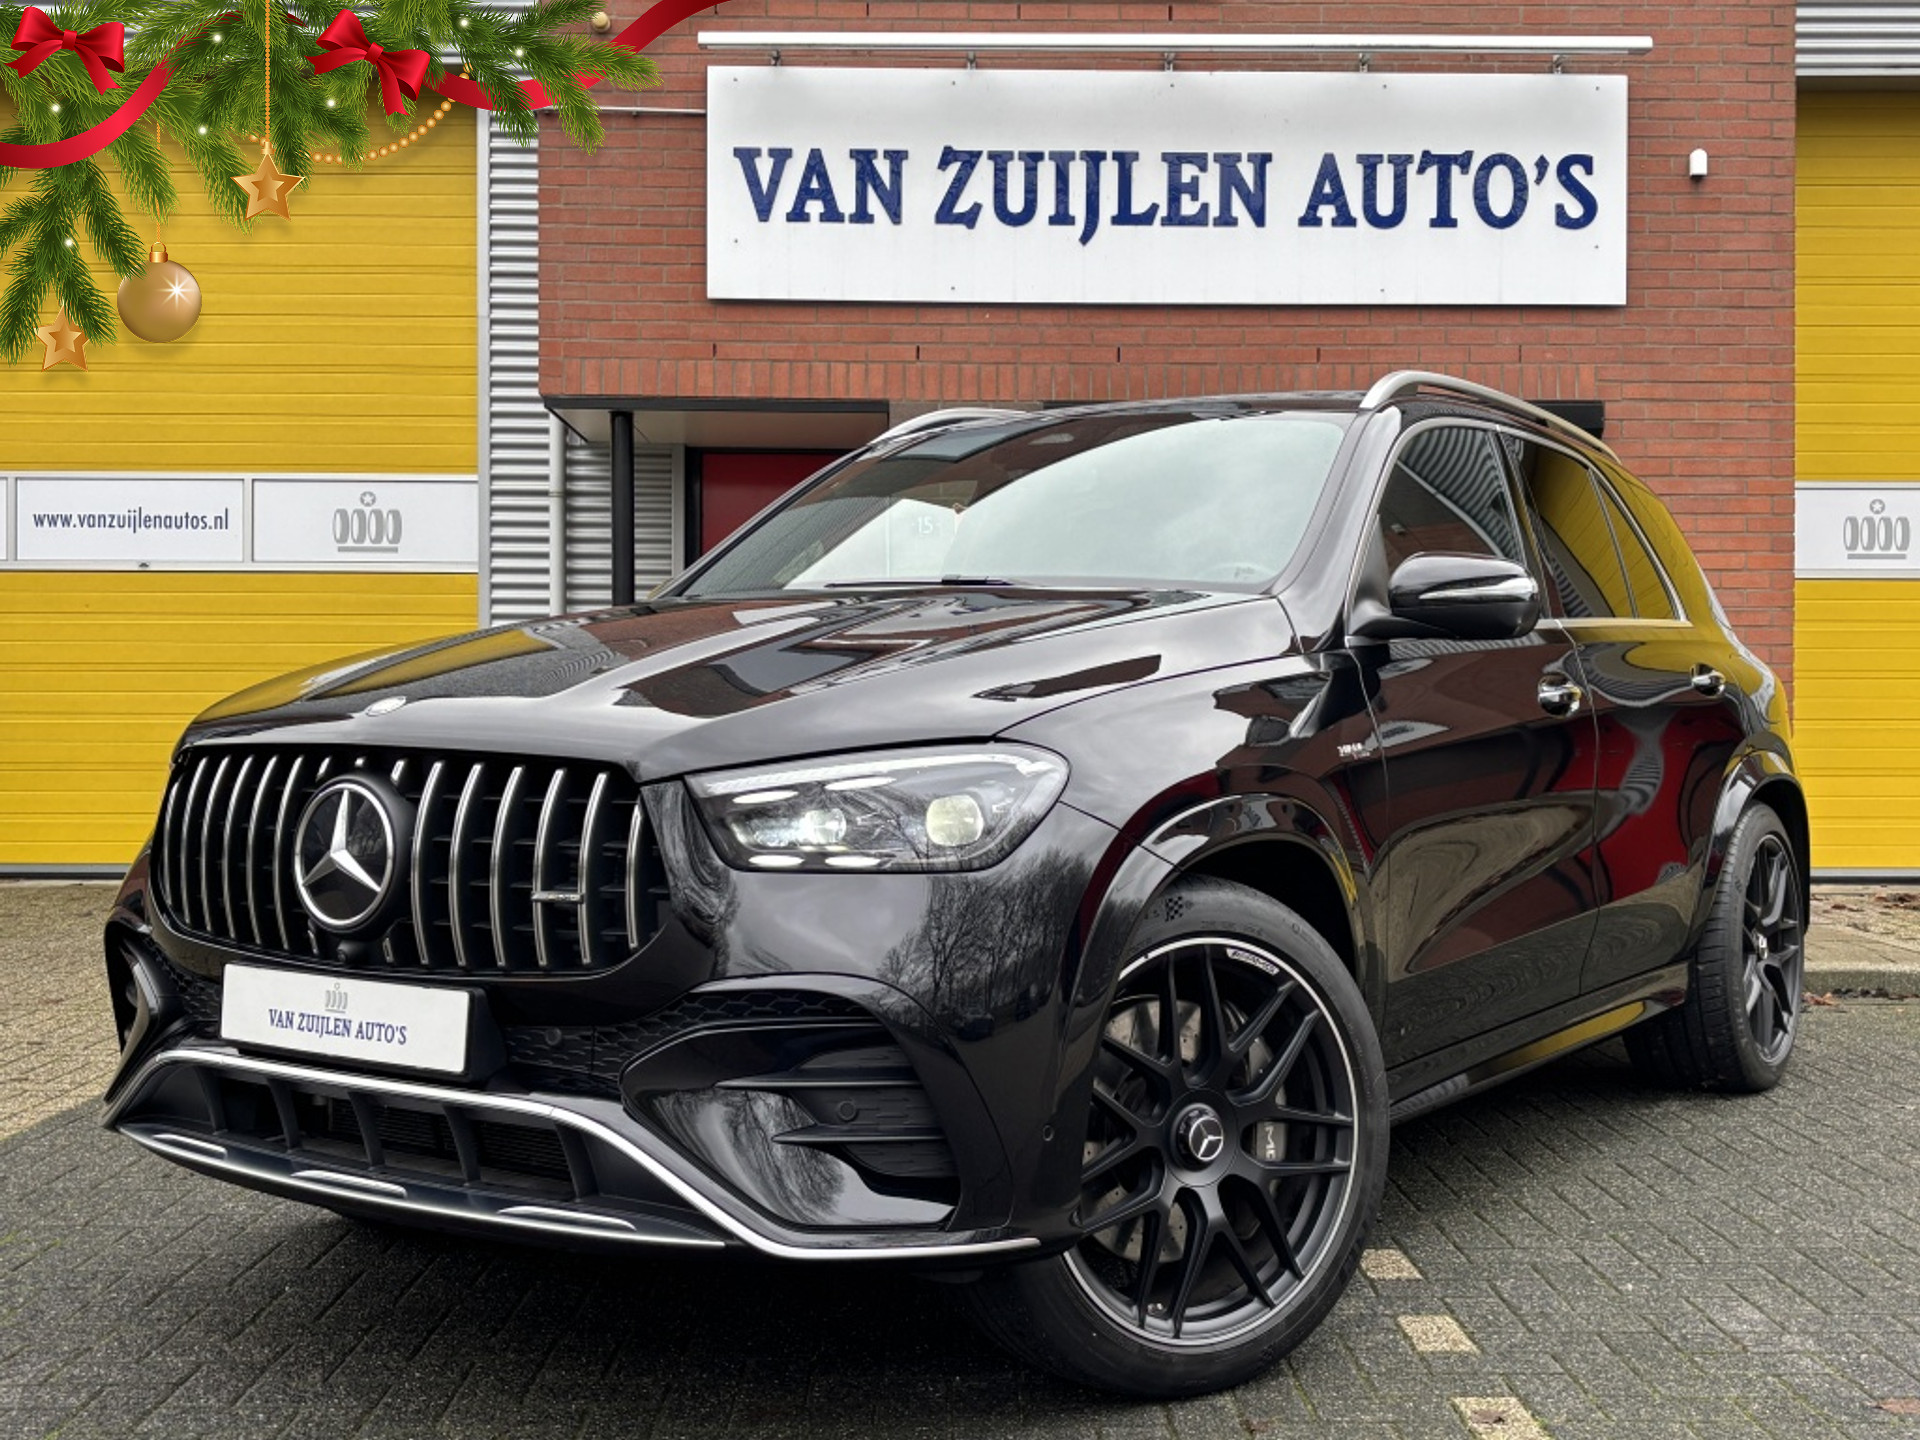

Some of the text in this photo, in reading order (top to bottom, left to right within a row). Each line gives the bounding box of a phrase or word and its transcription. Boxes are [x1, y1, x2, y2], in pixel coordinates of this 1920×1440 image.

[733, 145, 1600, 247] VAN ZUIJLEN AUTO'S
[32, 506, 229, 534] www.vanzuijlenautos.nl
[268, 1008, 407, 1045] VAN ZUIJLEN AUTO'S
